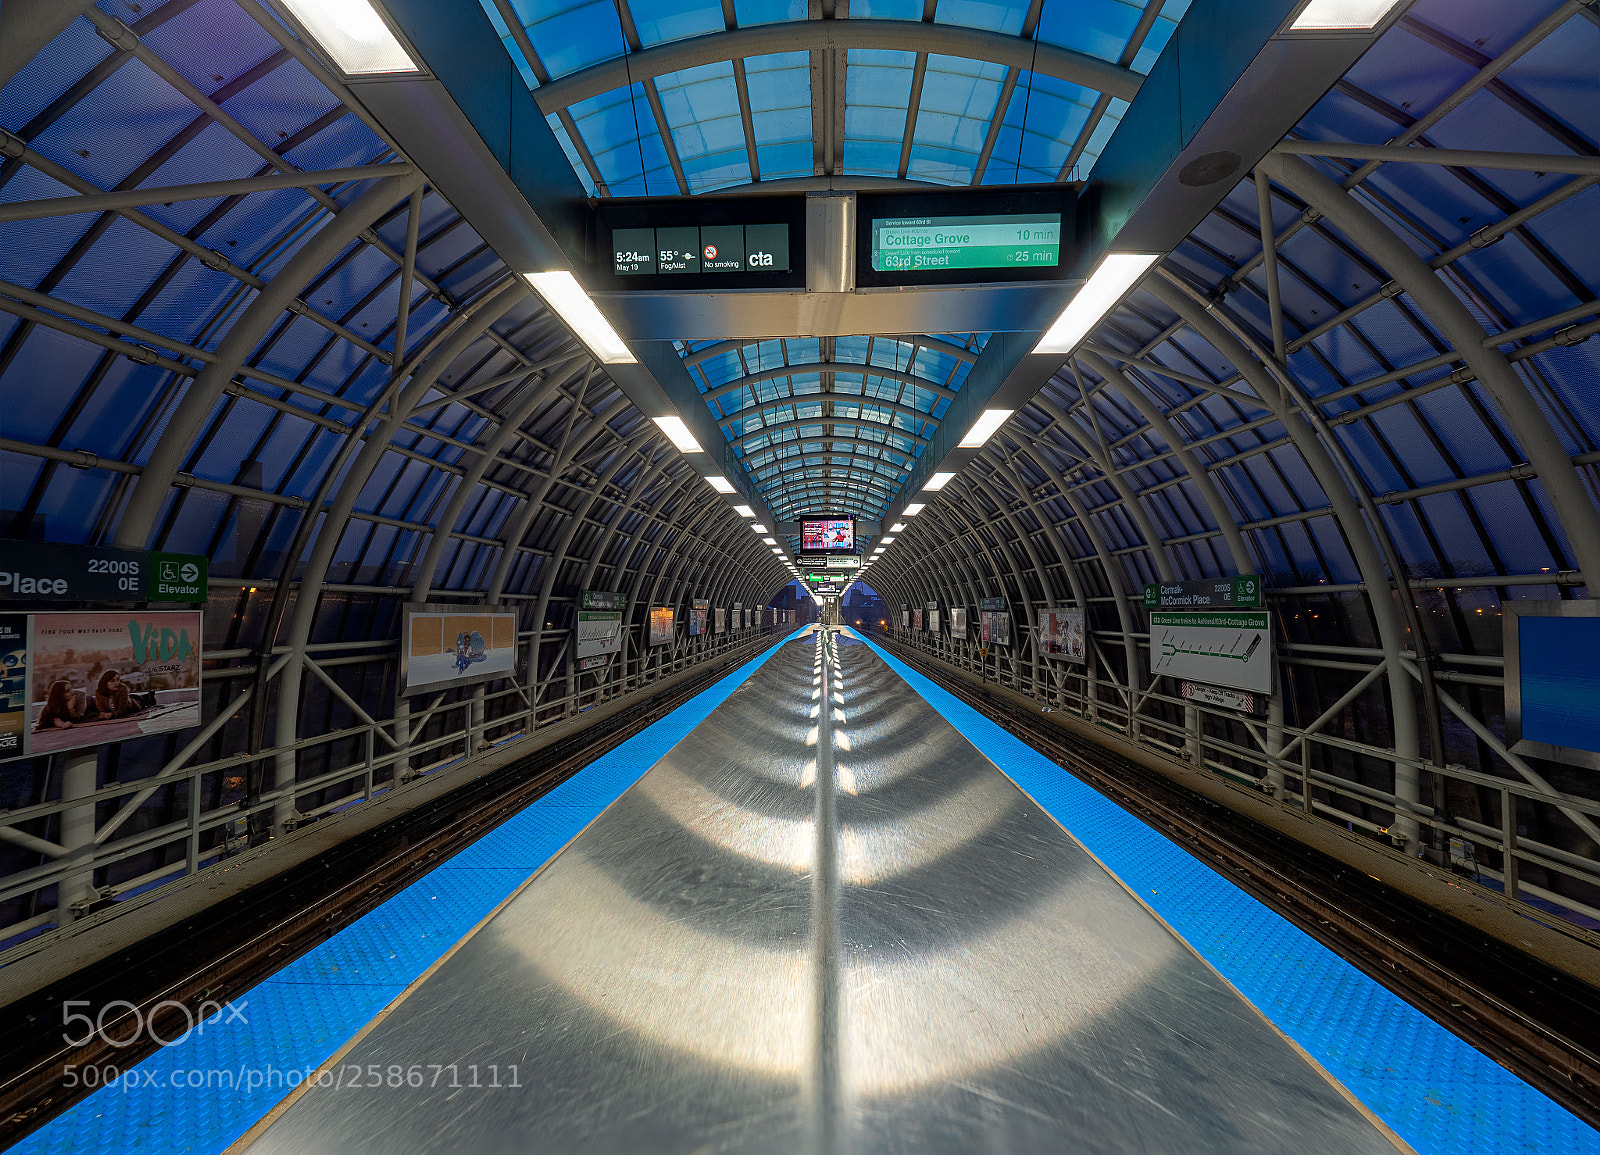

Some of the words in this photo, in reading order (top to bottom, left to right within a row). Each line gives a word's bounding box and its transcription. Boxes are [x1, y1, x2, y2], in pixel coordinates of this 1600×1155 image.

[885, 235, 931, 247] Cottage
[934, 233, 970, 244] Grove
[1016, 229, 1030, 240] 10
[1033, 229, 1054, 240] min
[616, 251, 650, 262] 5:24am
[660, 250, 679, 261] 55°
[749, 251, 773, 267] cta
[885, 255, 911, 267] 63rd
[914, 255, 949, 267] Street
[1015, 251, 1029, 262] 25
[1032, 250, 1053, 261] min
[630, 263, 639, 271] 19
[660, 262, 686, 270] Fog/Mist
[714, 260, 739, 269] smoking
[87, 559, 140, 575] 2200S
[0, 572, 68, 594] Place
[118, 577, 139, 591] 0E
[1214, 584, 1231, 592] 2200S
[158, 583, 200, 595] Elevator
[1161, 595, 1192, 606] McCormick
[1192, 594, 1210, 605] Place
[1248, 619, 1265, 627] Grove
[158, 664, 181, 672] STARZ
